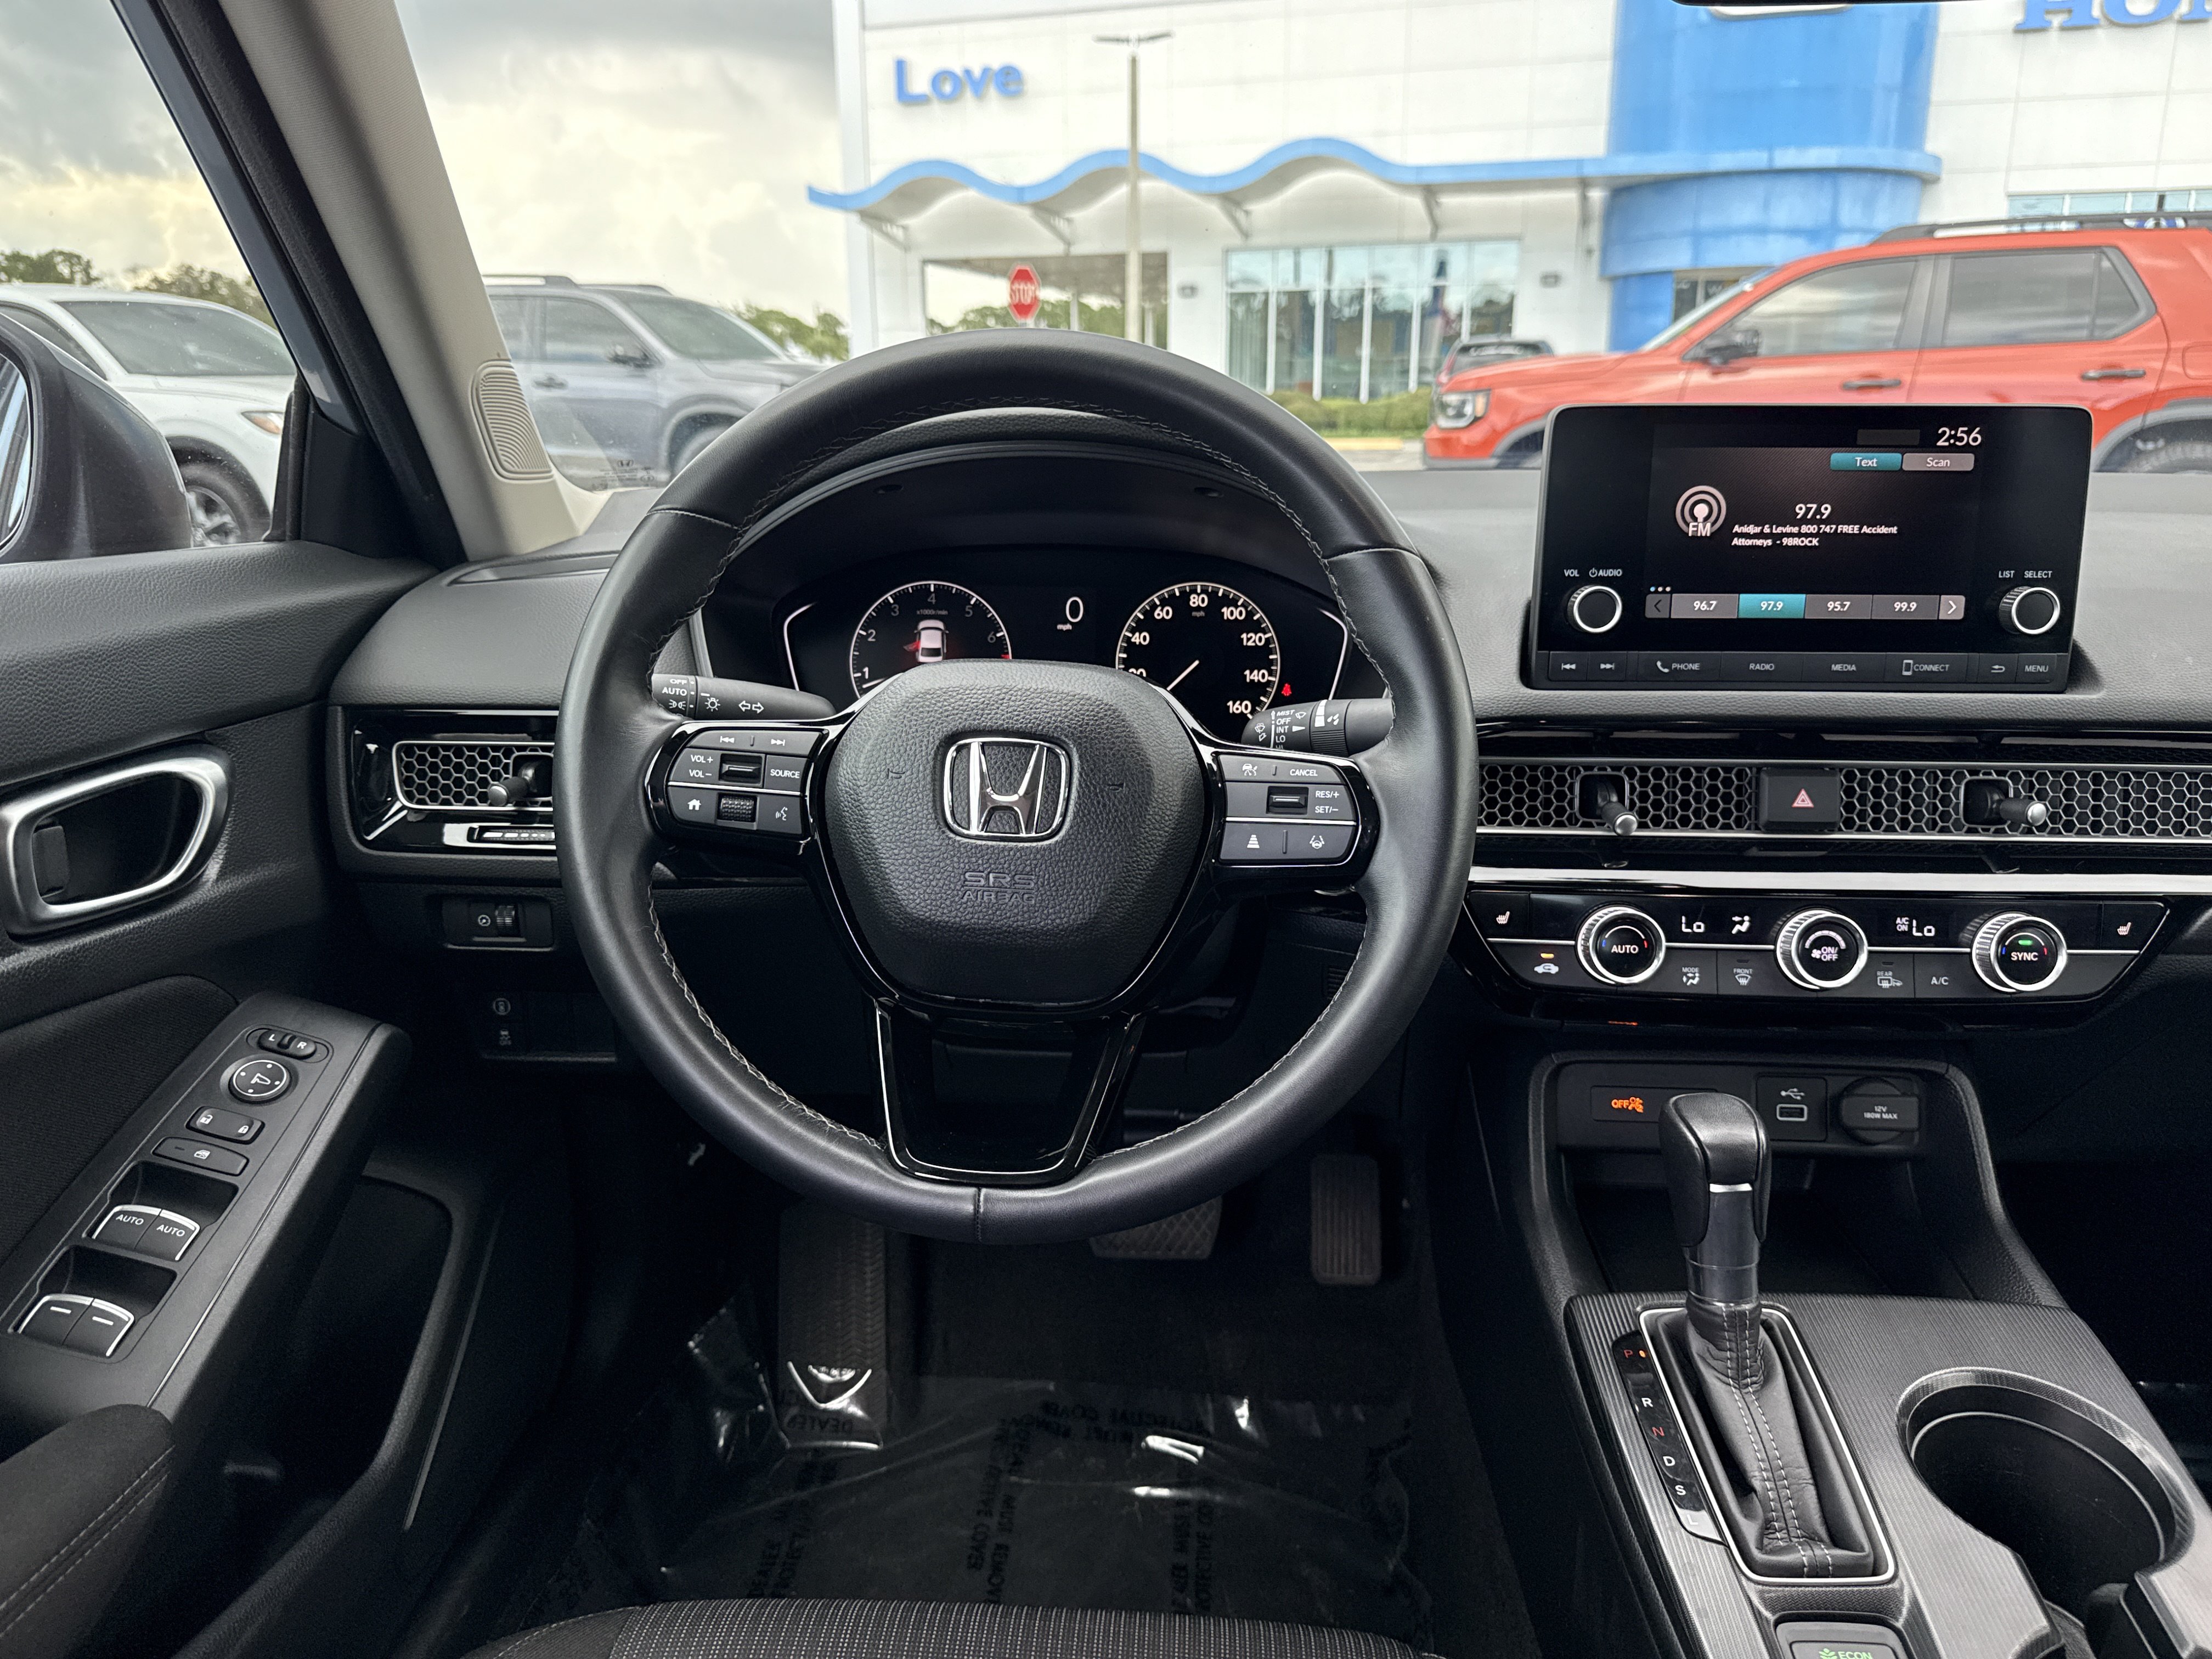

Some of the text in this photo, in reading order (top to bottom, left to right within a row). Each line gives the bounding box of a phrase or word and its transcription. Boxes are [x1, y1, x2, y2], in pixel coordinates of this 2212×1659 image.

[895, 58, 1024, 103] Love
[1009, 281, 1036, 305] STOP
[1936, 427, 1982, 446] 2:56
[1855, 457, 1878, 467] Text
[1926, 457, 1951, 467] Scan
[1795, 504, 1832, 519] 97.9
[1688, 523, 1712, 537] FM
[1732, 524, 1898, 535] Anidjar & Levine 800 747 FREE Accident
[1731, 537, 1773, 548] Attorneys
[1781, 537, 1820, 547] 98ROCK
[1564, 568, 1623, 577] VOL AUDIO
[1998, 570, 2015, 578] LIST
[2023, 570, 2053, 578] SELECT
[927, 593, 936, 605] 4
[1189, 594, 1209, 607] 80
[891, 605, 900, 616] 3
[964, 606, 973, 617] 5
[1065, 596, 1085, 623] 0
[1693, 601, 1717, 611] 96.7
[1760, 601, 1784, 611] 97.9
[1826, 601, 1851, 612] 95.7
[1893, 601, 1917, 612] 99.9
[1153, 606, 1173, 620] 60
[1221, 606, 1246, 620] 100
[1056, 623, 1073, 631] mph
[867, 629, 876, 642] 2
[987, 631, 996, 643] 6
[1131, 631, 1150, 645] 40
[1240, 633, 1266, 646] 120
[1671, 662, 1700, 670] PHONE
[1831, 663, 1857, 672] MEDIA
[1914, 663, 1950, 672] CONNECT
[2024, 664, 2049, 673] MENU
[862, 667, 870, 679] 1
[1244, 669, 1269, 682] 140
[662, 686, 687, 696] AUTO
[1227, 700, 1252, 714] 160
[1276, 717, 1291, 725] OFF
[1276, 725, 1289, 733] INT
[1275, 735, 1286, 743] LO
[770, 769, 800, 778] SOURCE
[964, 871, 1035, 888] SRS
[961, 890, 1036, 905] AIRBAG
[1611, 945, 1639, 953] AUTO
[1821, 946, 1838, 954] ON/
[2011, 952, 2038, 961] SYNC
[1931, 977, 1949, 985] A/C
[297, 1041, 307, 1049] R
[1611, 1099, 1629, 1109] OFF
[115, 1212, 144, 1226] AUTO
[156, 1223, 186, 1238] AUTO
[1623, 1349, 1634, 1359] P
[1641, 1397, 1654, 1408] R
[1652, 1426, 1666, 1437] N
[1663, 1455, 1676, 1468] D
[1675, 1485, 1687, 1496] S
[1686, 1514, 1699, 1526] L
